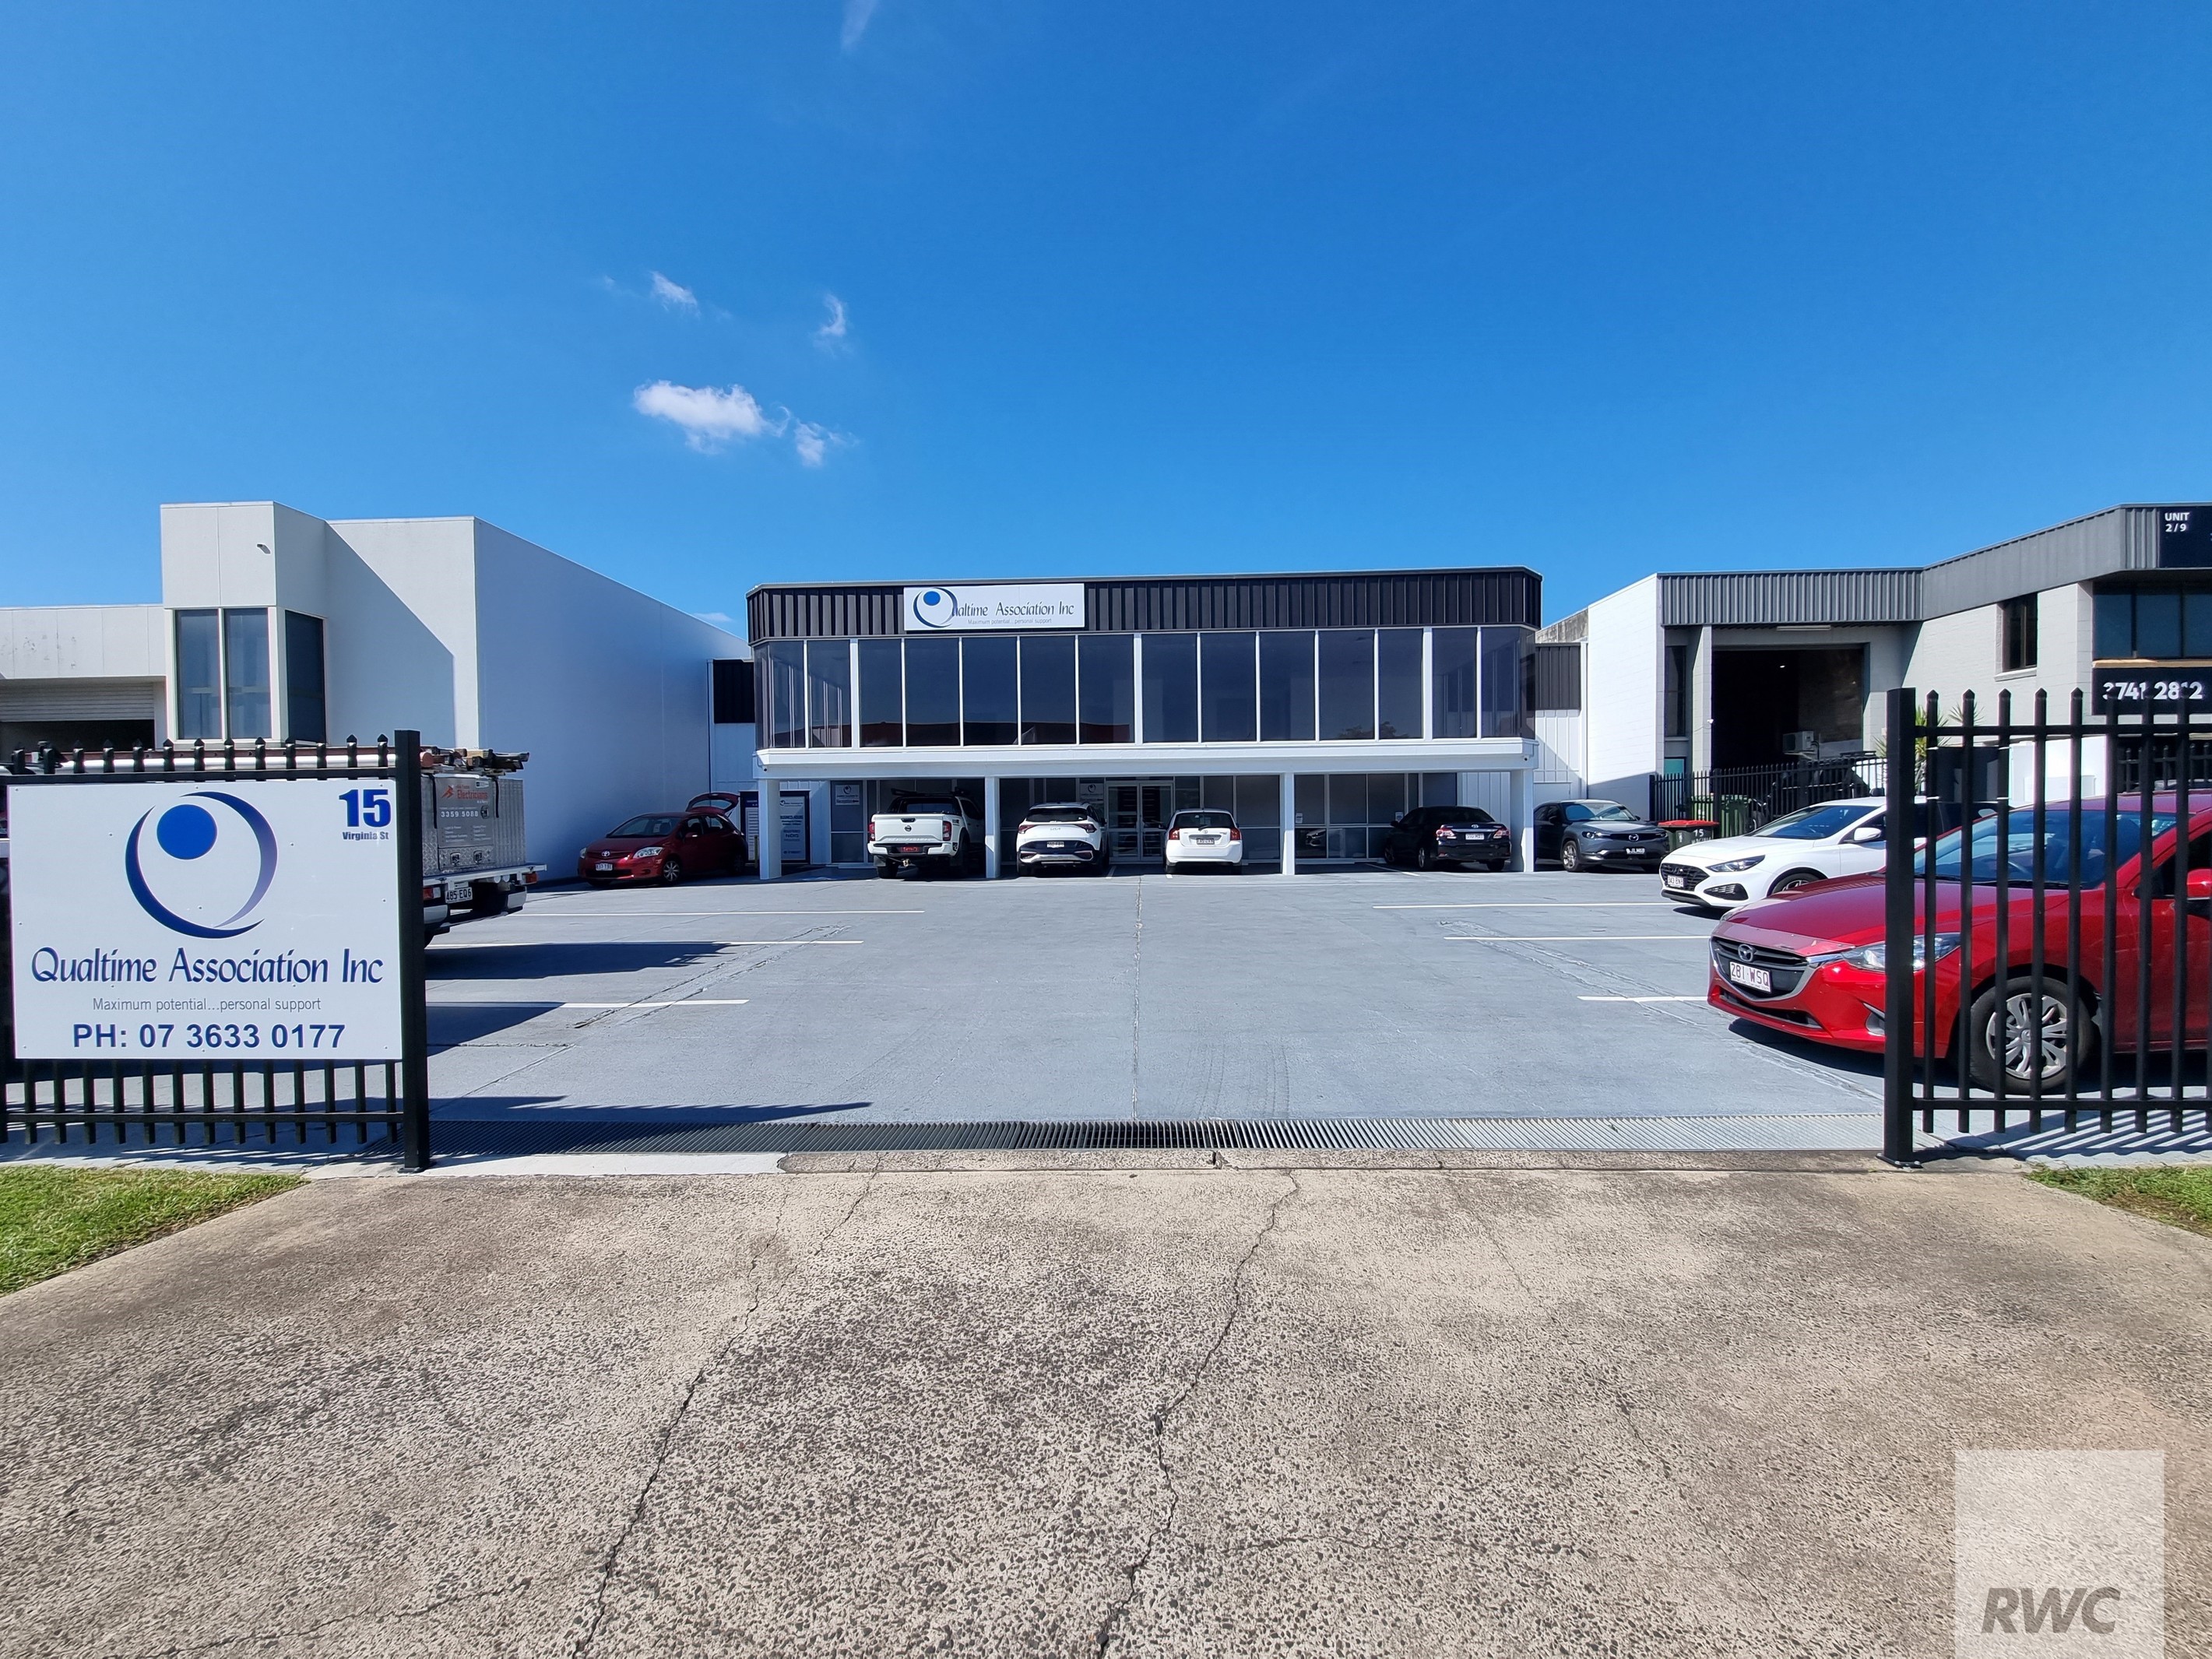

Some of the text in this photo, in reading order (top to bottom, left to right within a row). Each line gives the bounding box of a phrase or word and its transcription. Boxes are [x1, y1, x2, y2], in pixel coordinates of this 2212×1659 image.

[2165, 512, 2190, 522] UNIT
[996, 601, 1054, 617] Association
[1059, 601, 1074, 615] Inc
[339, 789, 392, 828] 15
[343, 831, 389, 841] Virginia St
[1693, 828, 1704, 837] 15
[31, 946, 384, 983] Qualtime Association Inc
[93, 997, 152, 1011] Maximum
[275, 997, 322, 1013] support
[73, 1024, 345, 1049] PH: 07 3633 0177
